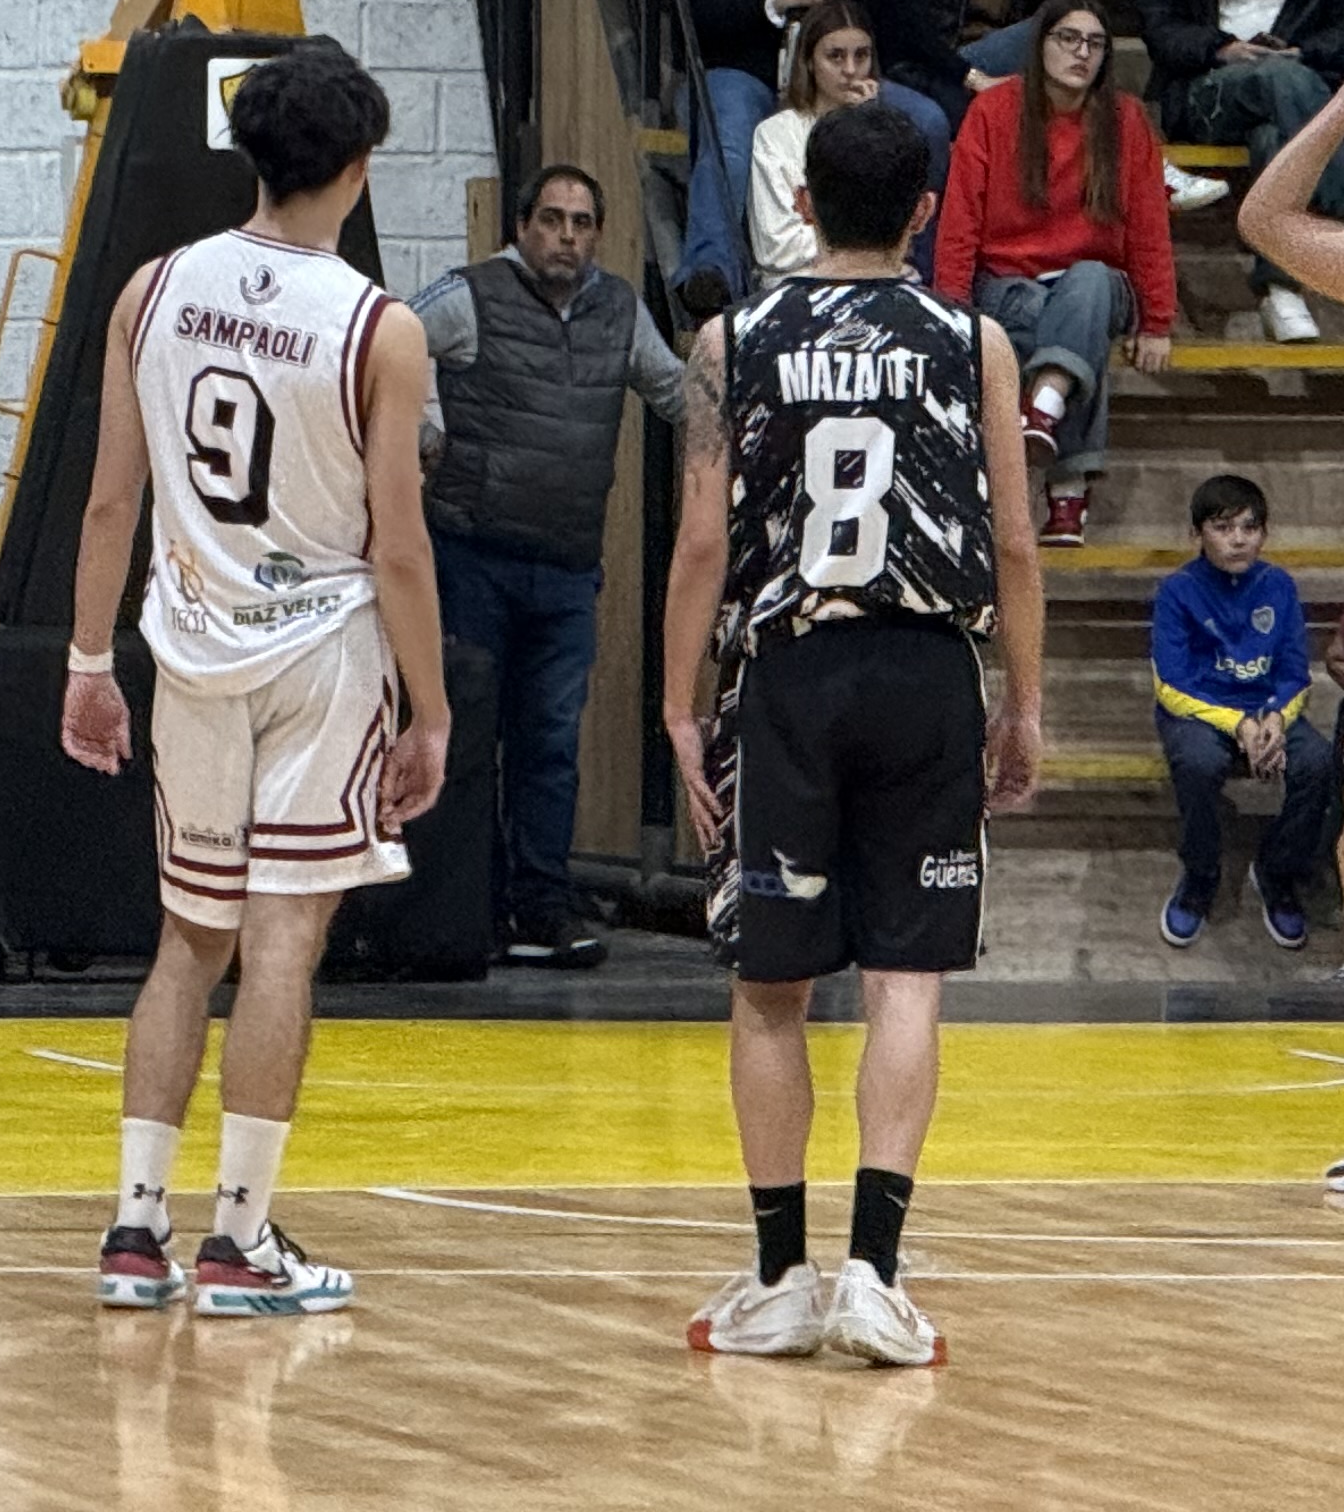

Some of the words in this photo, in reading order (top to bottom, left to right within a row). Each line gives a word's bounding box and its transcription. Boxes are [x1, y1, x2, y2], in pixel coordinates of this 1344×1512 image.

[175, 303, 318, 369] SAMPAOLI
[185, 365, 276, 527] 9
[798, 416, 896, 588] 8
[233, 605, 278, 626] DIAZ
